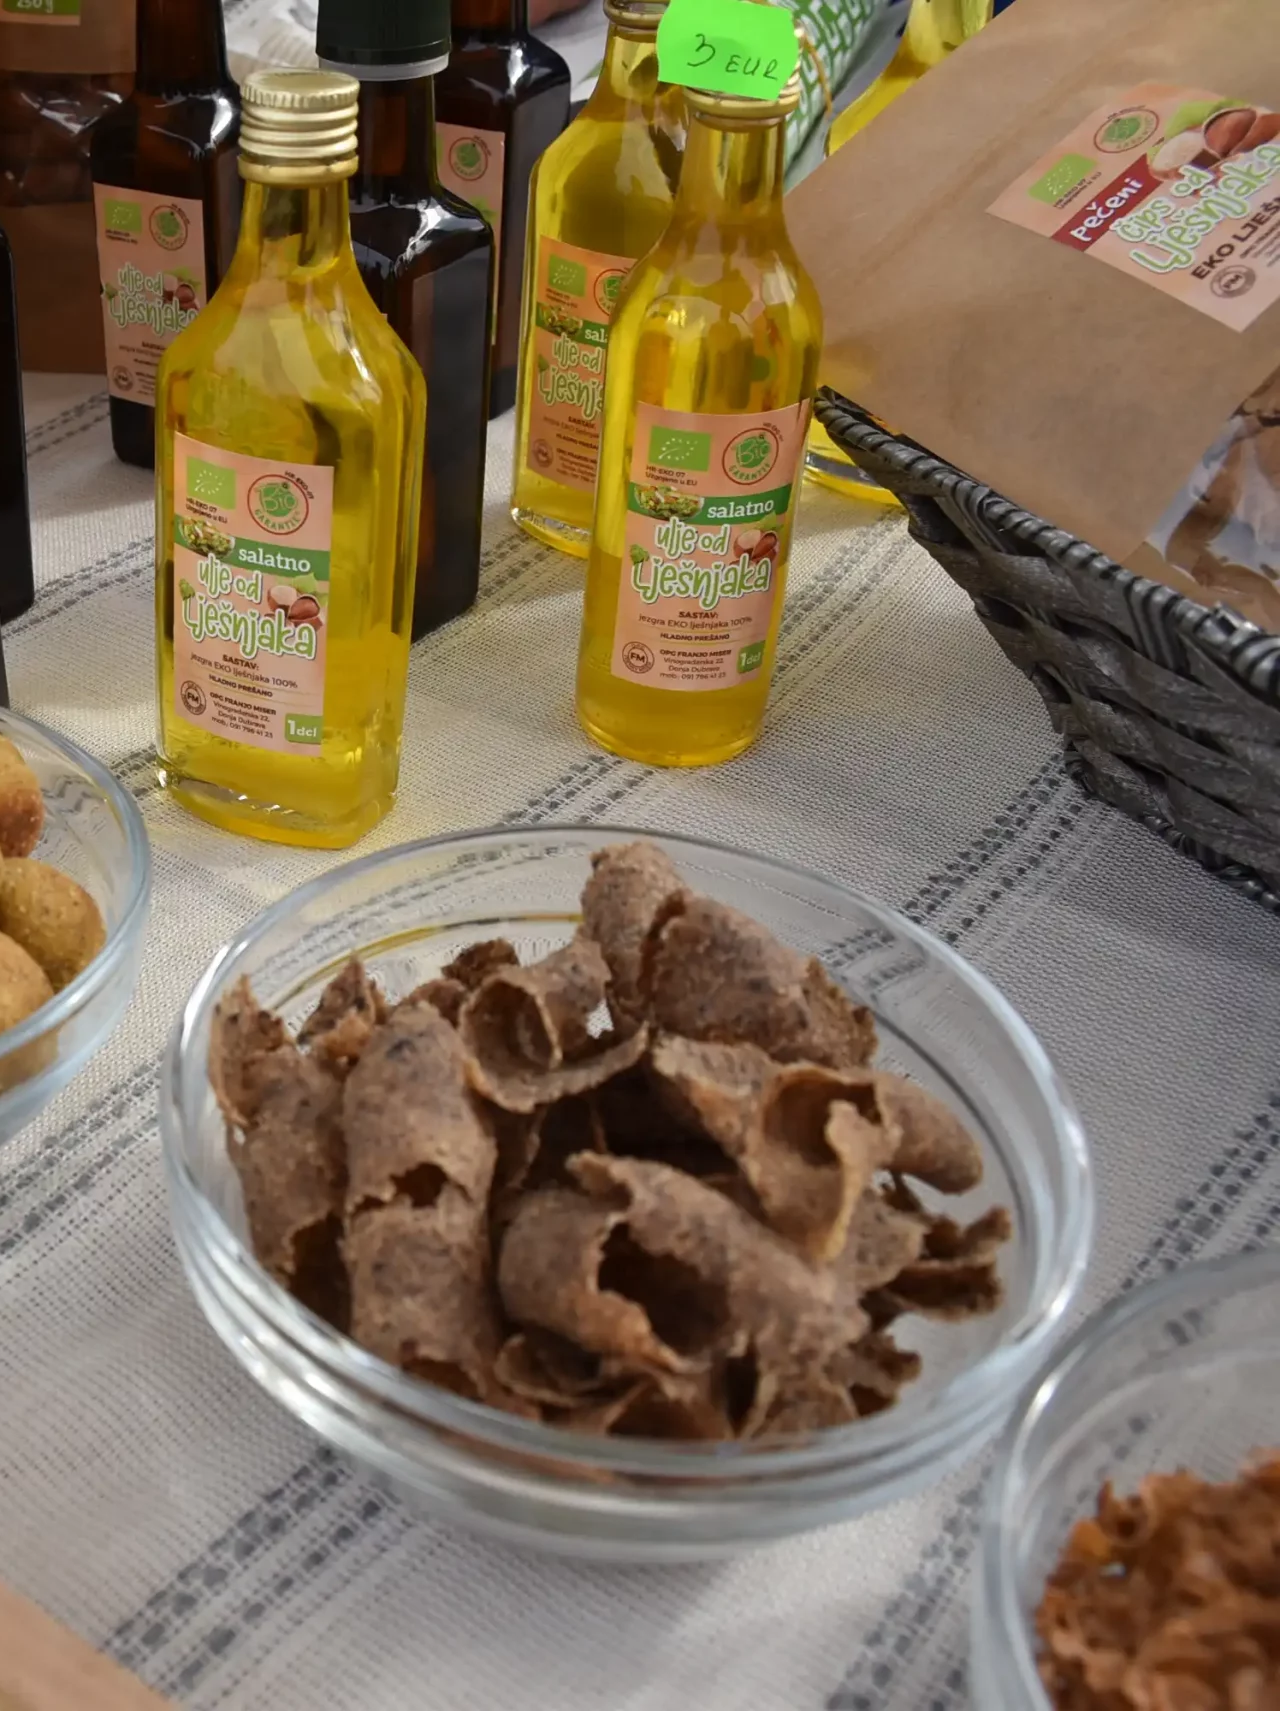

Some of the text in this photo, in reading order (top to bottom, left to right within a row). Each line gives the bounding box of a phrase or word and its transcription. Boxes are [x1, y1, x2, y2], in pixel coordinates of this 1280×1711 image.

[725, 54, 779, 81] EUR
[1169, 164, 1215, 197] od
[1191, 243, 1235, 280] EKO
[1231, 197, 1280, 242] LJEŠ
[118, 262, 163, 297] ulje od
[552, 332, 602, 373] ulje od
[254, 508, 301, 531] GARANTIE
[707, 499, 774, 519] salatno
[655, 516, 731, 559] ulje od
[238, 548, 311, 573] salatno
[197, 552, 263, 604] ulje od
[631, 552, 772, 611] Lješnjaka
[182, 594, 318, 661] Lješnjaka
[639, 613, 753, 630] jezgra EKO lješnjaka 100%
[678, 611, 719, 619] SASTAV:
[660, 632, 730, 642] HLADNO PREŠANO
[190, 652, 299, 689] jezgra EKO lješnjaka 100%
[222, 654, 260, 671] SASTAV:
[630, 651, 645, 664] FM
[209, 674, 273, 698] HLADNO PREŠANO
